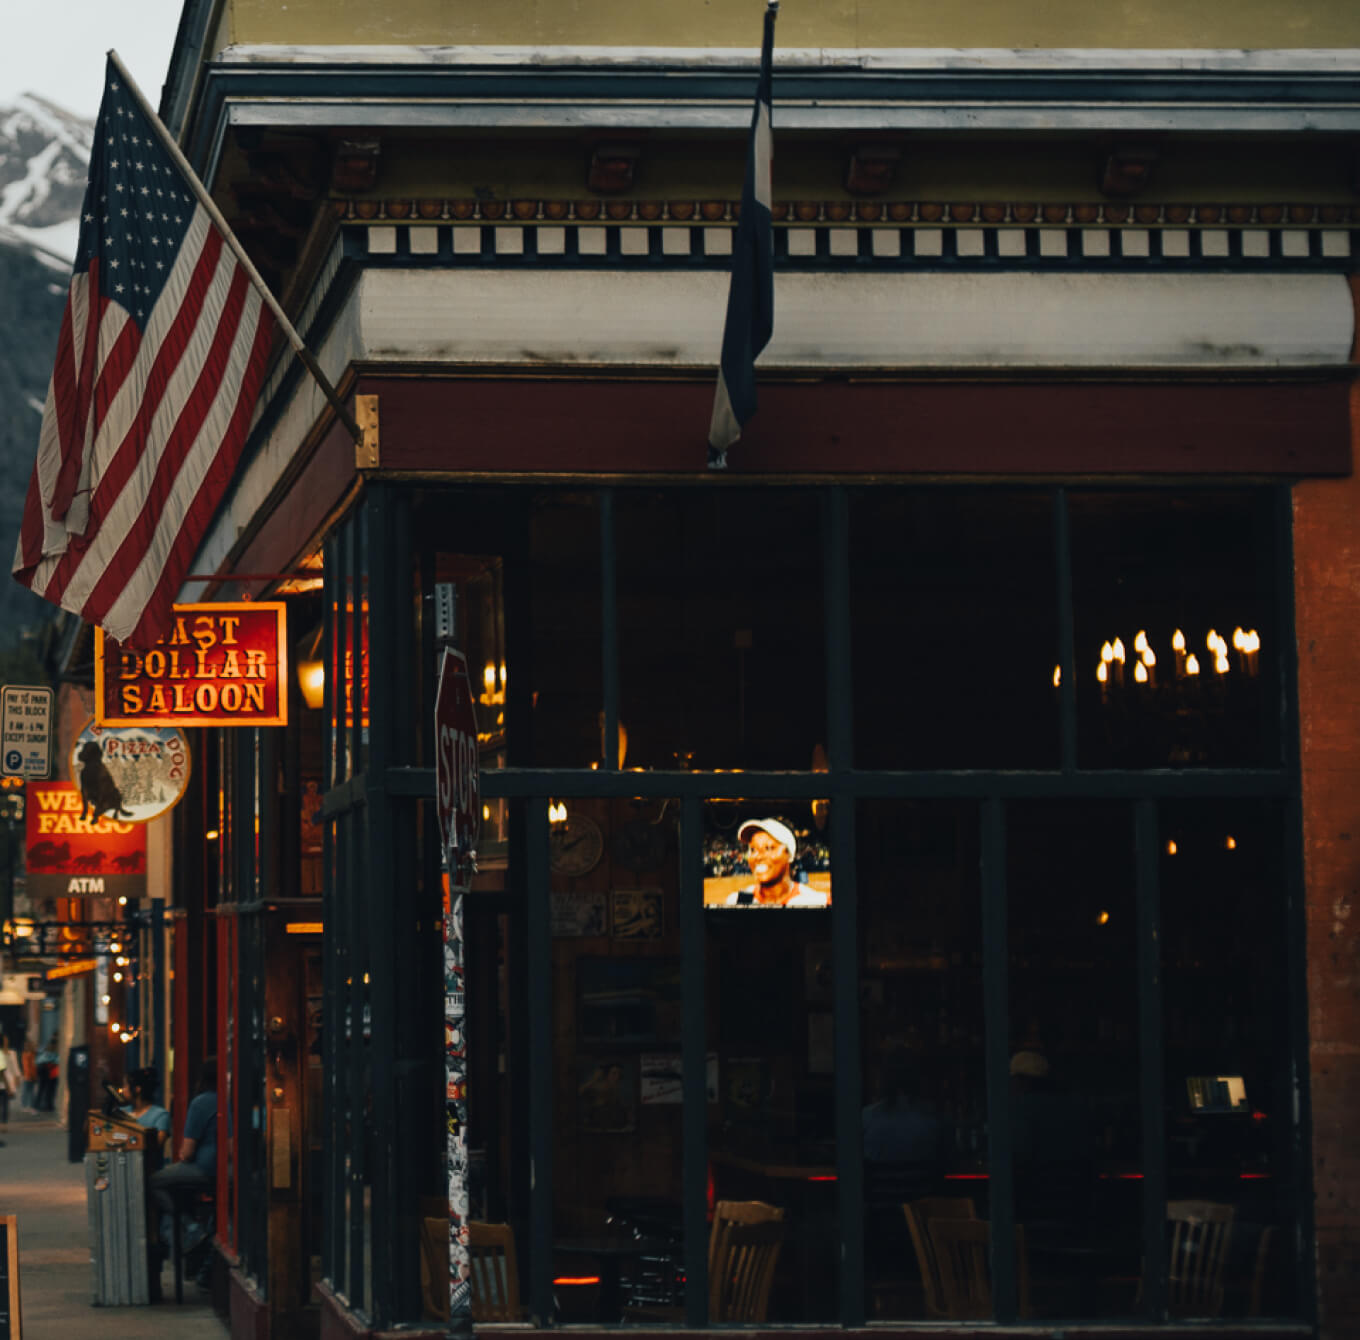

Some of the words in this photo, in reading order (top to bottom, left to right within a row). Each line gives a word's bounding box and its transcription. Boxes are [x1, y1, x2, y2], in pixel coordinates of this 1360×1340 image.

[120, 649, 267, 680] DOLLAR
[31, 695, 48, 704] PARK
[122, 683, 266, 714] SALOON
[8, 705, 23, 715] THIS
[25, 706, 47, 716] BLOCK
[107, 739, 161, 754] PIZZA
[10, 754, 19, 767] P
[166, 737, 185, 779] DOG
[440, 722, 476, 816] STOP
[67, 877, 105, 894] ATM
